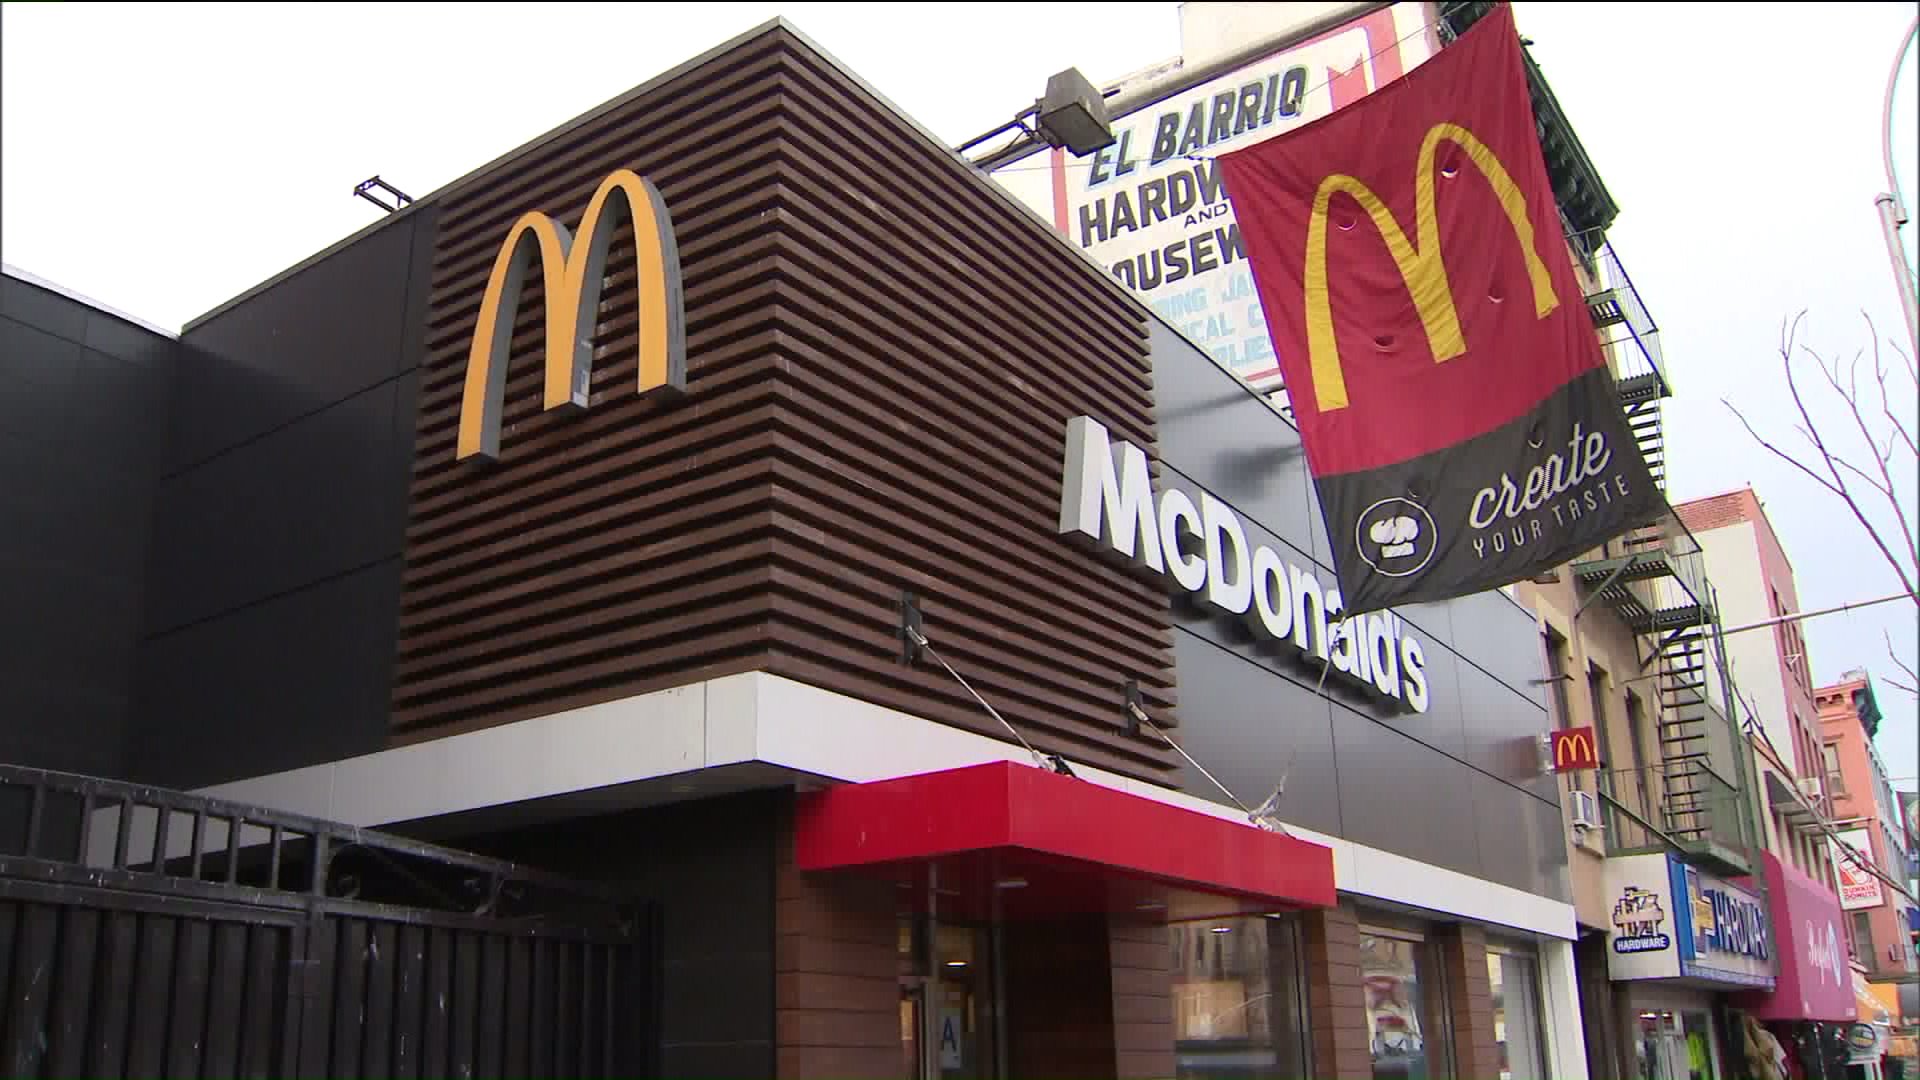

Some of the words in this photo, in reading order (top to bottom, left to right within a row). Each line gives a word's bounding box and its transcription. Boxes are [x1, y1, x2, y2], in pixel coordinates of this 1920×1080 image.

[1088, 128, 1136, 186] EL
[1150, 66, 1307, 166] BARRIO
[1079, 162, 1231, 248] HARDW
[1184, 203, 1228, 228] AND
[1111, 223, 1250, 291] OUSEW
[1470, 422, 1611, 529] create
[1473, 519, 1543, 558] YOUR
[1552, 474, 1630, 527] TASTE
[1061, 415, 1429, 714] McDonald's
[1616, 937, 1667, 951] HARDWARE
